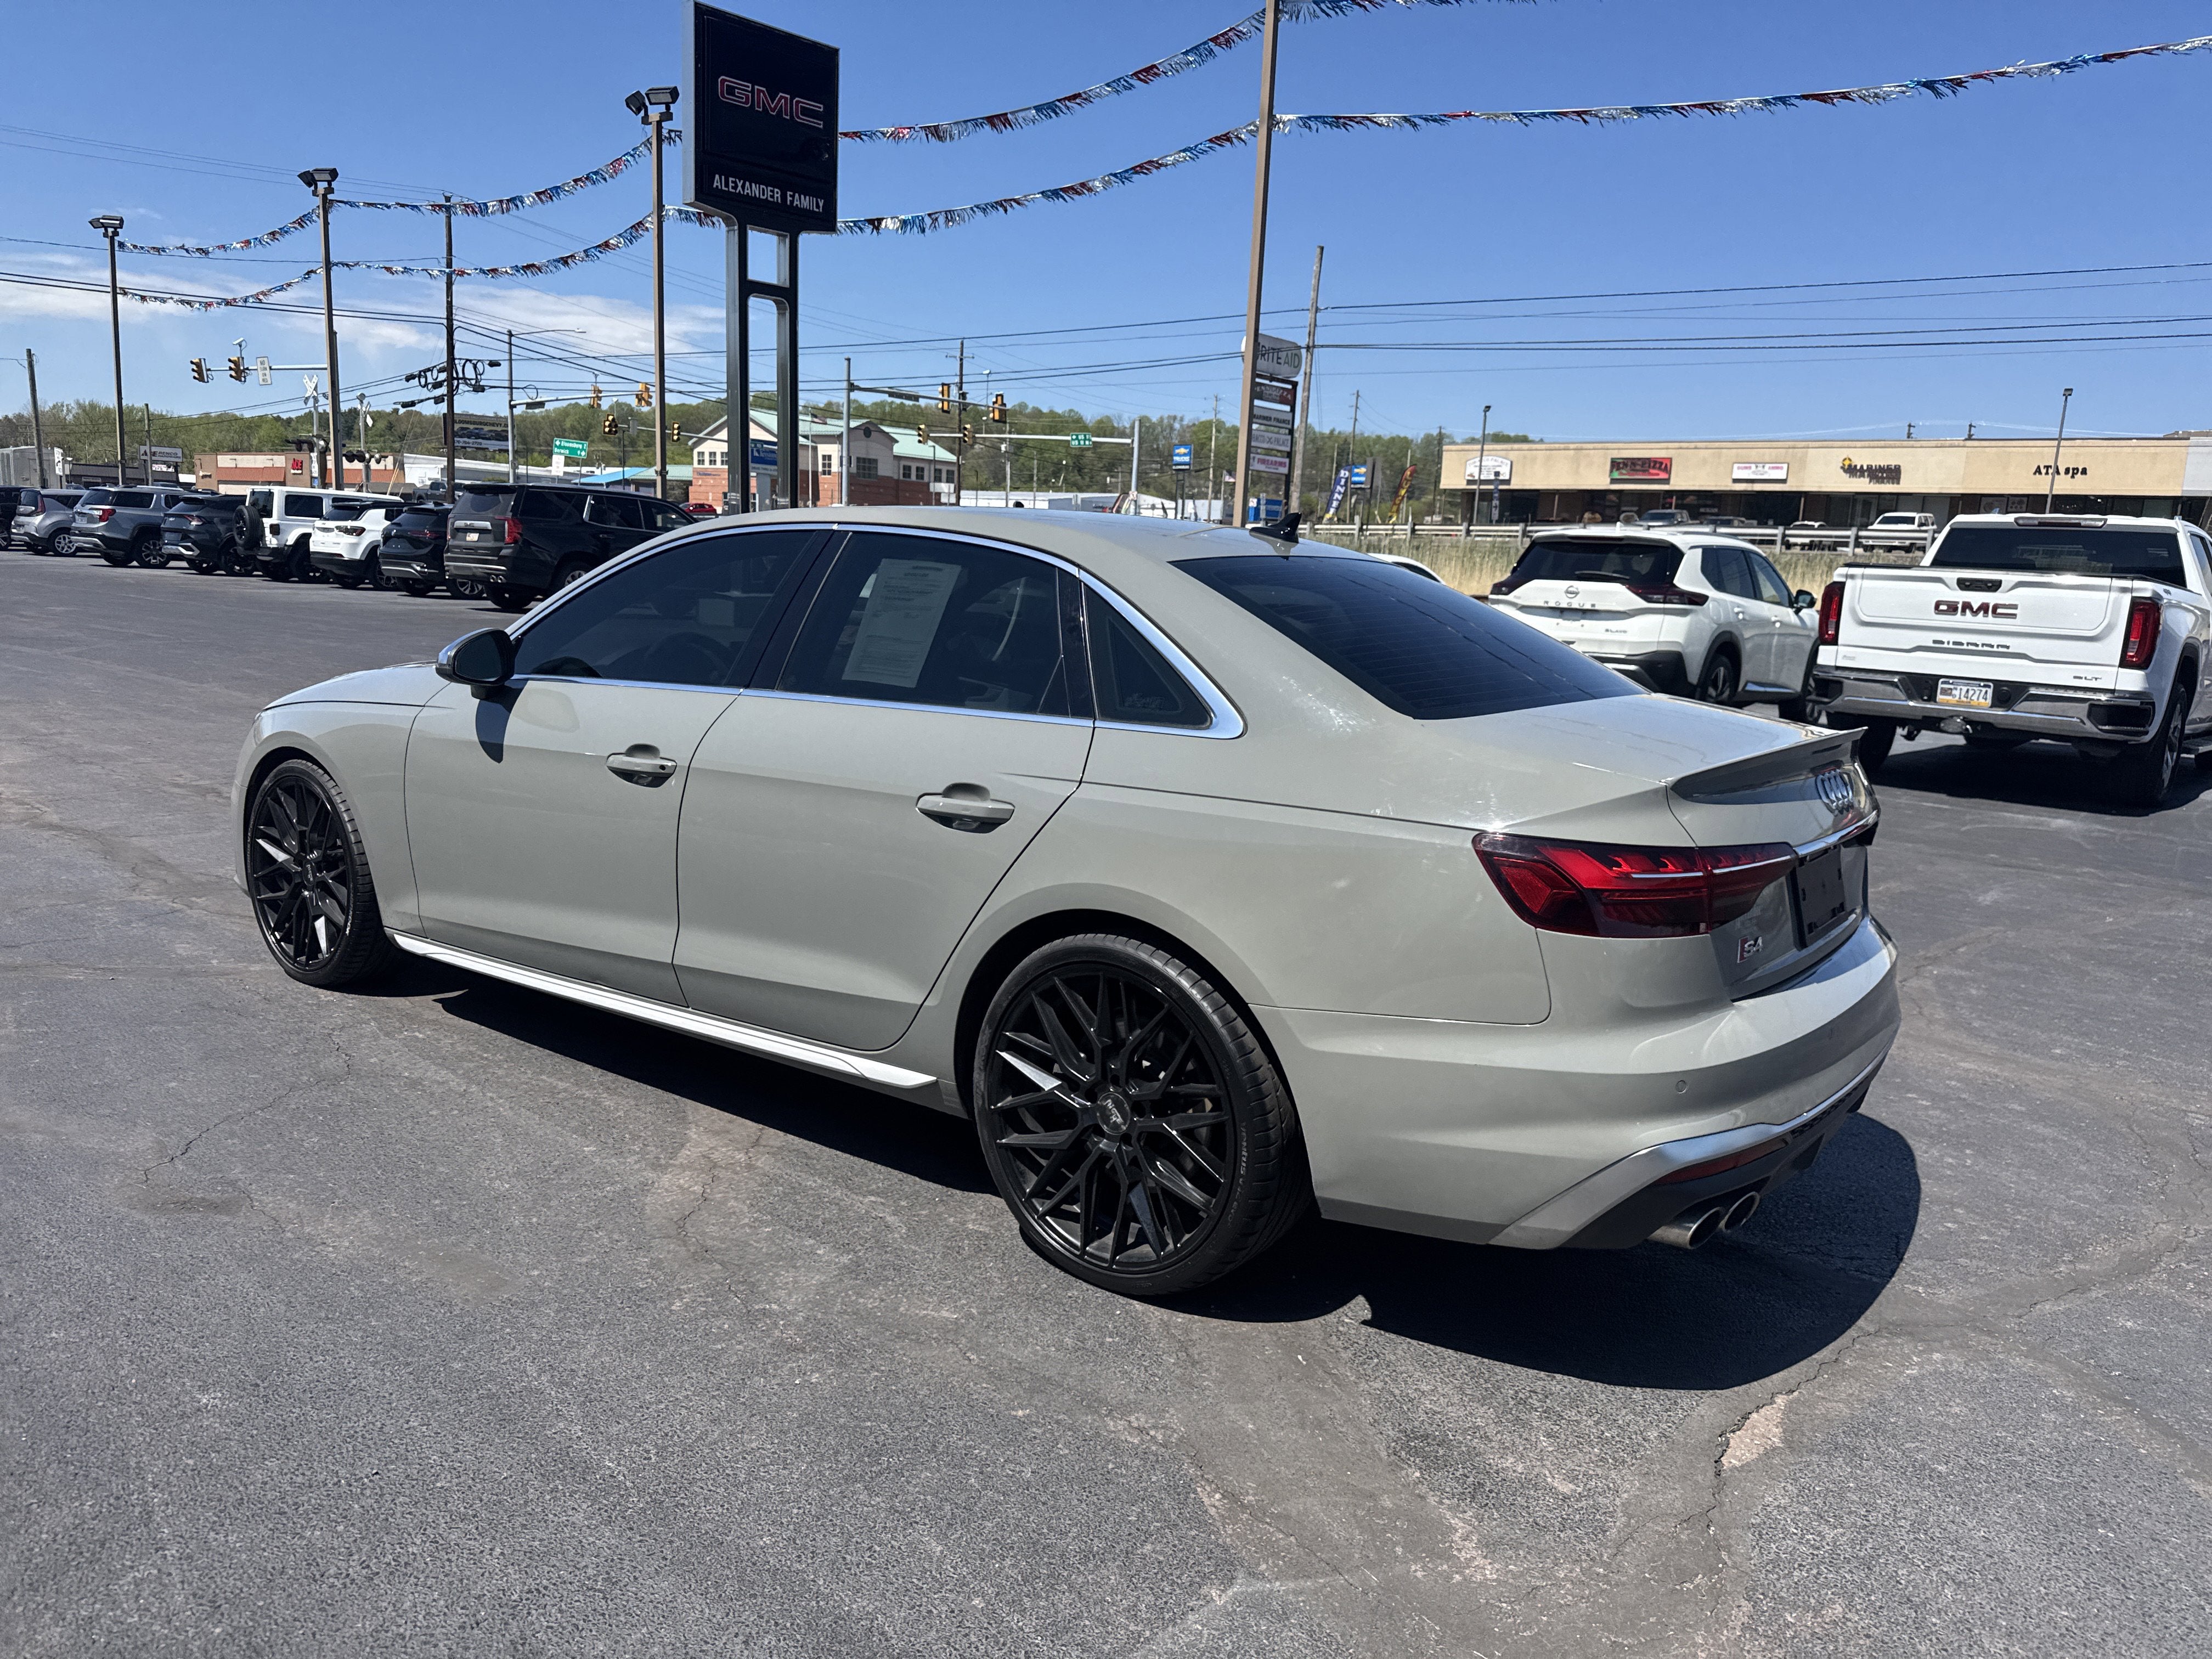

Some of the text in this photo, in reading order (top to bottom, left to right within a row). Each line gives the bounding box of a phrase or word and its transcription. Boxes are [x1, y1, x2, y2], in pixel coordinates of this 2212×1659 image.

[718, 75, 823, 129] GMC
[713, 174, 825, 213] ALEXANDER FAMILY
[1260, 345, 1300, 369] RITE AID
[561, 441, 583, 449] Bloomsburg
[1256, 458, 1287, 468] FIREARMS
[1847, 464, 1901, 473] MARINER
[2033, 465, 2087, 479] ATA spa
[1543, 600, 1596, 608] ROGUE
[1934, 600, 2018, 619] GMC
[1932, 639, 2010, 650] SIERRA
[1743, 936, 1763, 958] S4
